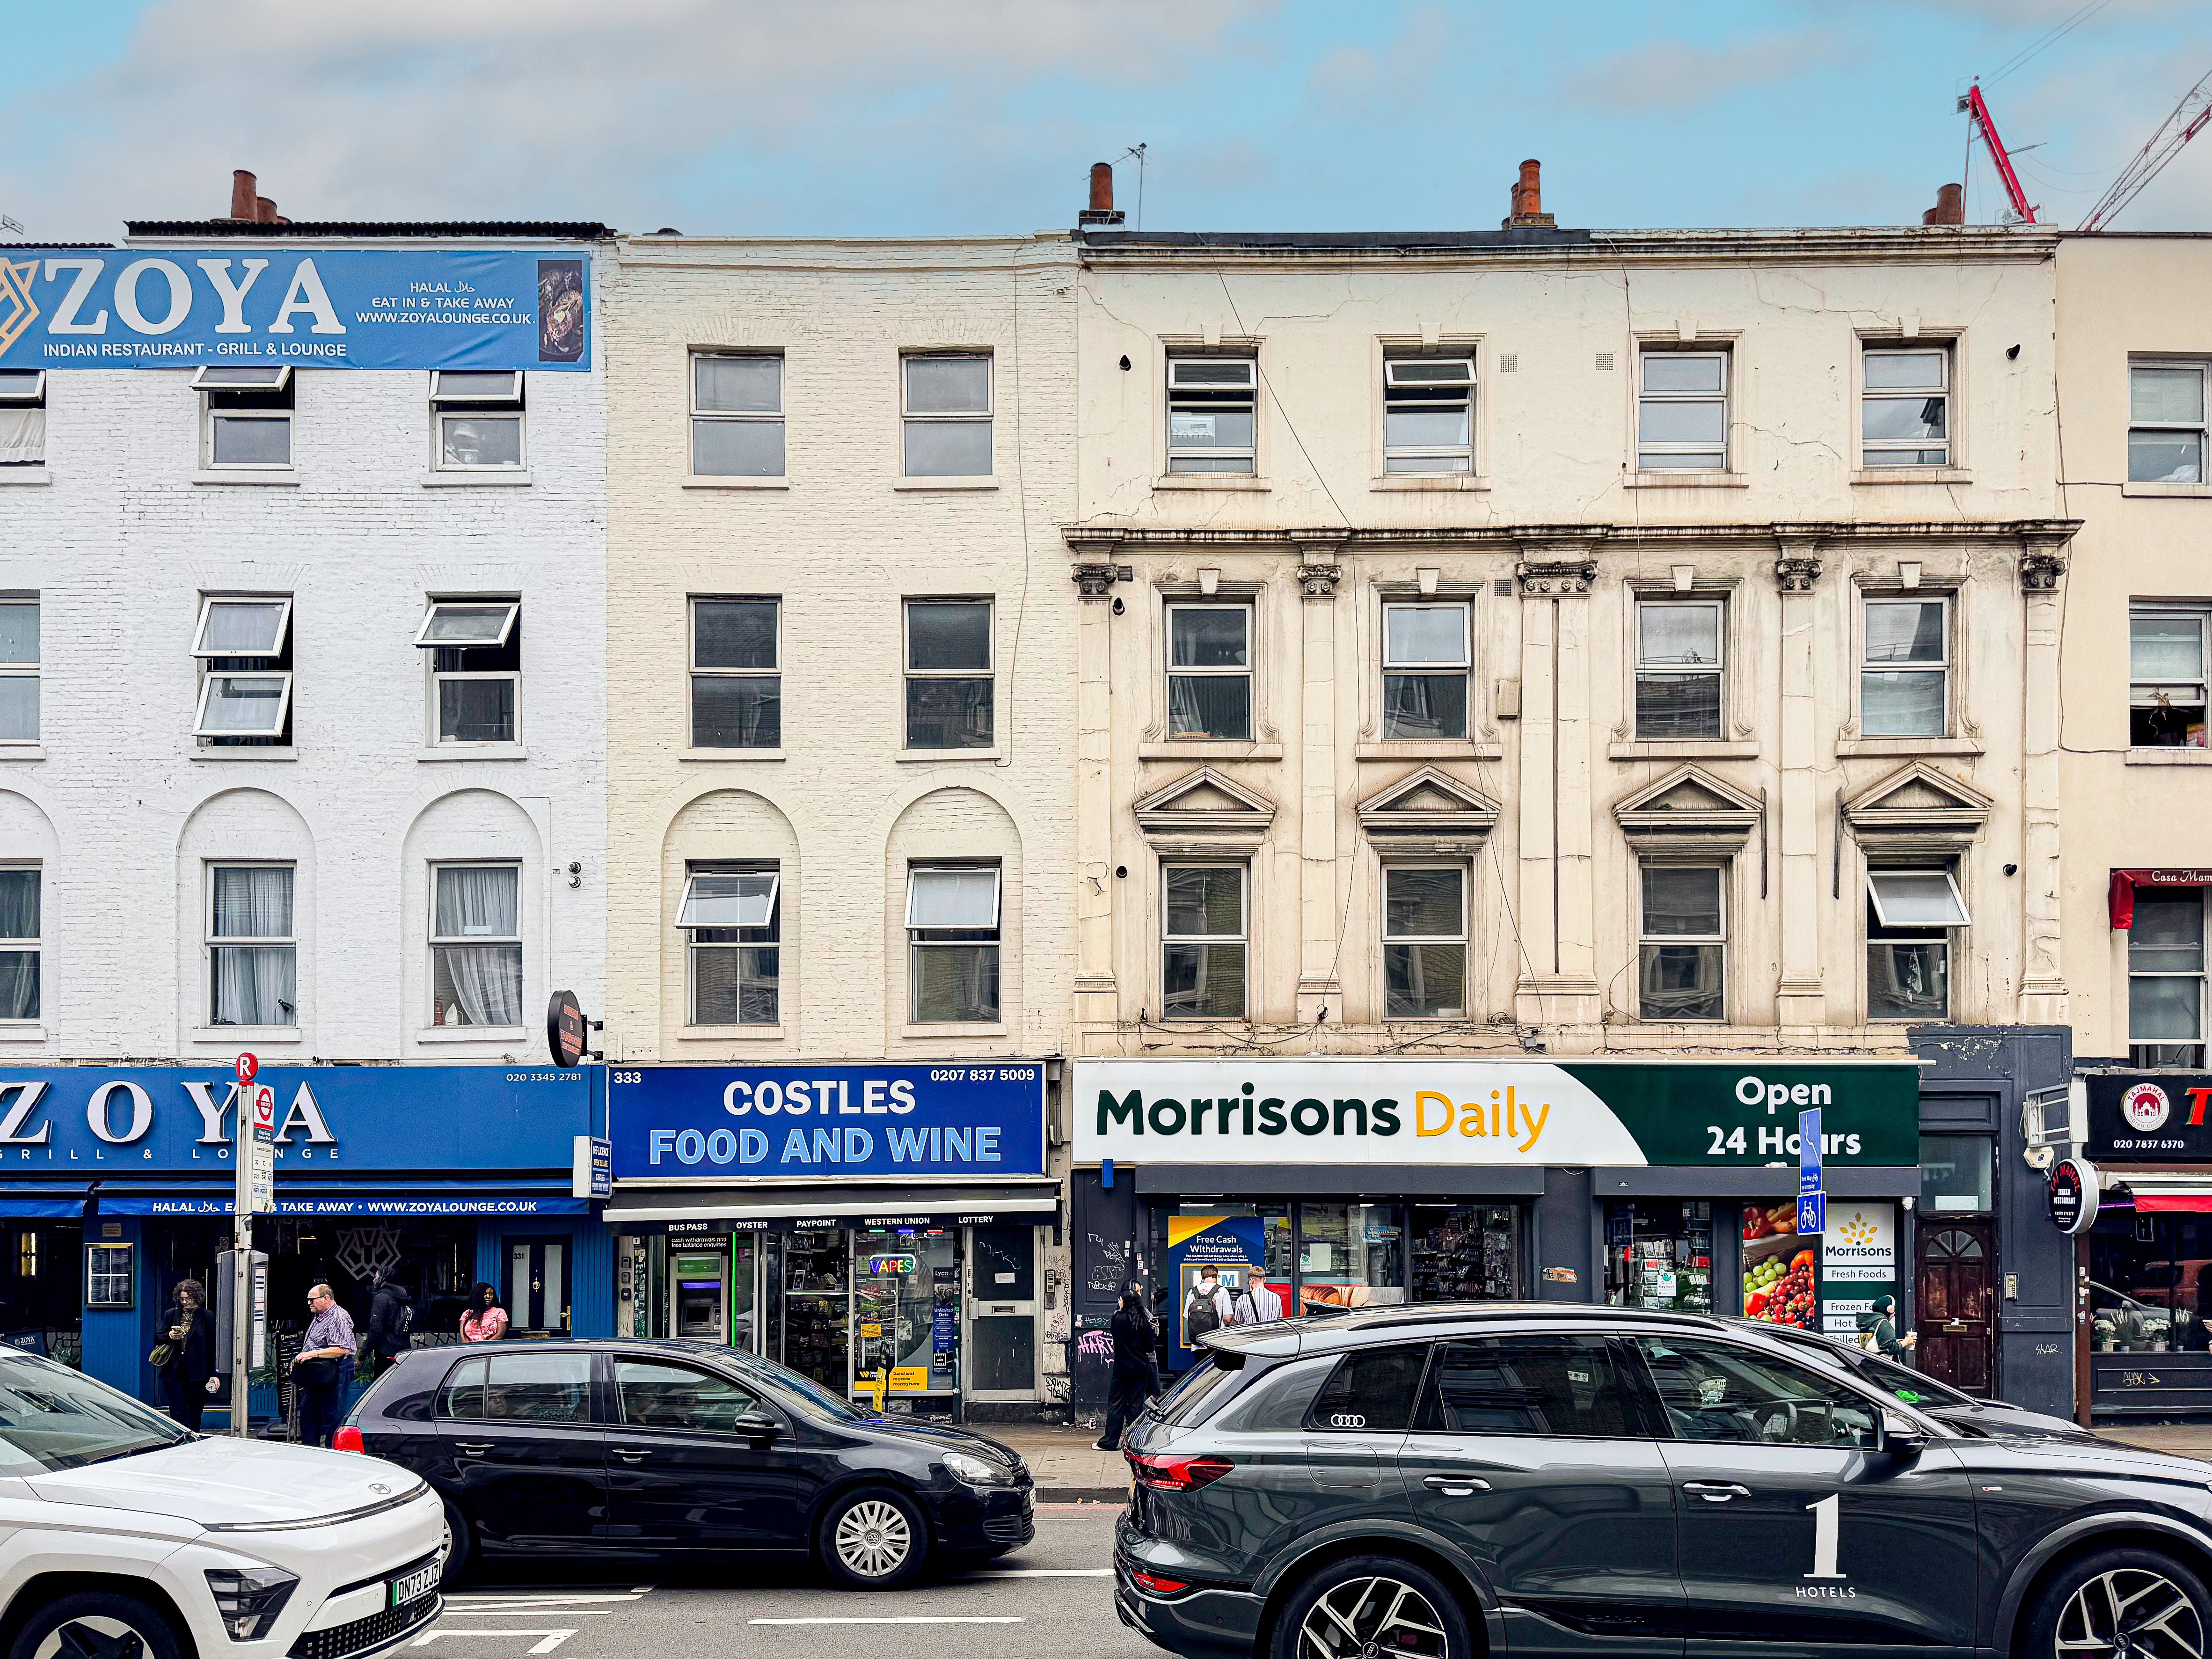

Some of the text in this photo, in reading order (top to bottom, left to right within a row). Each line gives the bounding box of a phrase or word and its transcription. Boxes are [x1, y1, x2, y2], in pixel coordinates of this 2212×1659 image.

[410, 282, 452, 293] HALAL
[44, 258, 347, 335] ZOYA
[372, 297, 515, 309] EAT IN & TAKE AWAY
[44, 343, 97, 357] INDIAN
[102, 343, 204, 356] RESTAURANT
[216, 343, 262, 356] GRILL
[266, 343, 278, 356] &
[282, 343, 347, 357] LOUNGE
[2152, 870, 2177, 882] Casa
[239, 1056, 252, 1077] R
[506, 1073, 582, 1082] 020 3345 2781
[613, 1072, 642, 1084] 333
[930, 1069, 1035, 1082] 0207 837 5009
[723, 1080, 916, 1116] COSTLES
[1735, 1076, 1832, 1114] Open
[2127, 1086, 2165, 1101] TAJMAHAL
[0, 1081, 338, 1143] ZOYA
[2184, 1087, 2212, 1125] T
[1096, 1082, 1550, 1153] Morrisons Daily
[650, 1127, 1001, 1164] FOOD AND WINE
[1707, 1126, 1747, 1155] 24
[2113, 1140, 2184, 1148] 020 7837 6370
[0, 1149, 104, 1159] RILL
[143, 1149, 153, 1159] &
[192, 1148, 338, 1159] LONGE
[153, 1202, 196, 1212] HALAL
[281, 1202, 315, 1212] TAKE
[317, 1202, 354, 1212] AWAY
[367, 1201, 537, 1212] WWW.ZOYALOUNGE.CO.UK
[1216, 1235, 1236, 1243] Cash
[1825, 1246, 1891, 1256] Morrisons
[869, 1259, 913, 1274] VAPES
[1832, 1269, 1886, 1278] Fresh Foods
[1803, 1493, 1847, 1579] 1
[398, 1572, 422, 1601] DN73
[424, 1564, 438, 1589] ZJZ
[1796, 1586, 1856, 1598] HOTELS
